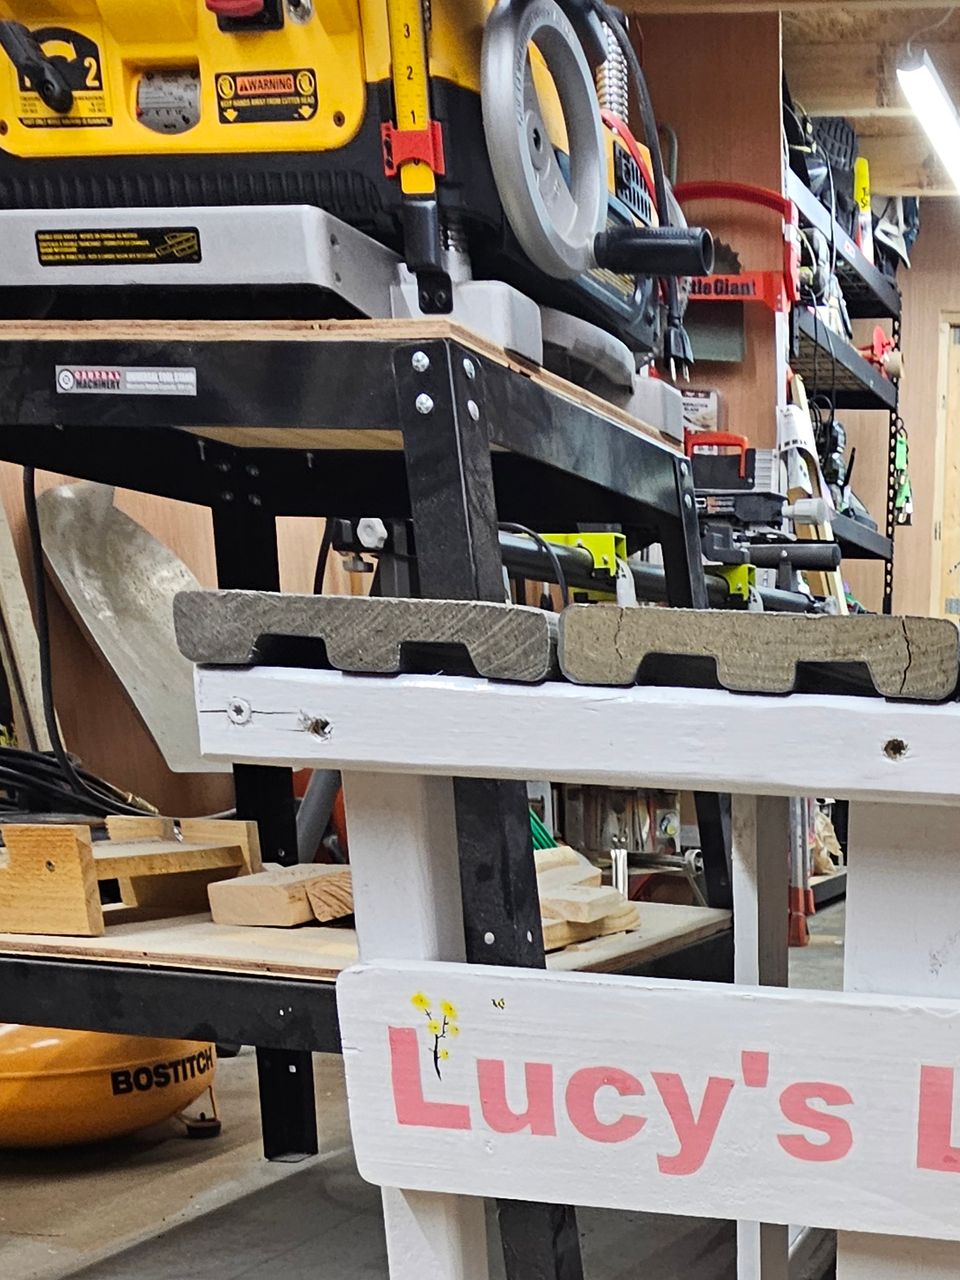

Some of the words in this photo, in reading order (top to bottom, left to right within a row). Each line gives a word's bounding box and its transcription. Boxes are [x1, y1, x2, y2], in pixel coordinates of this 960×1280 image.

[404, 23, 410, 39] 3
[84, 56, 100, 87] 2
[406, 65, 413, 80] 2
[248, 77, 293, 91] WARNING
[410, 110, 416, 125] 1
[714, 278, 757, 296] Giant
[111, 1046, 214, 1096] BOSTITCH
[388, 1025, 855, 1177] Lucy's
